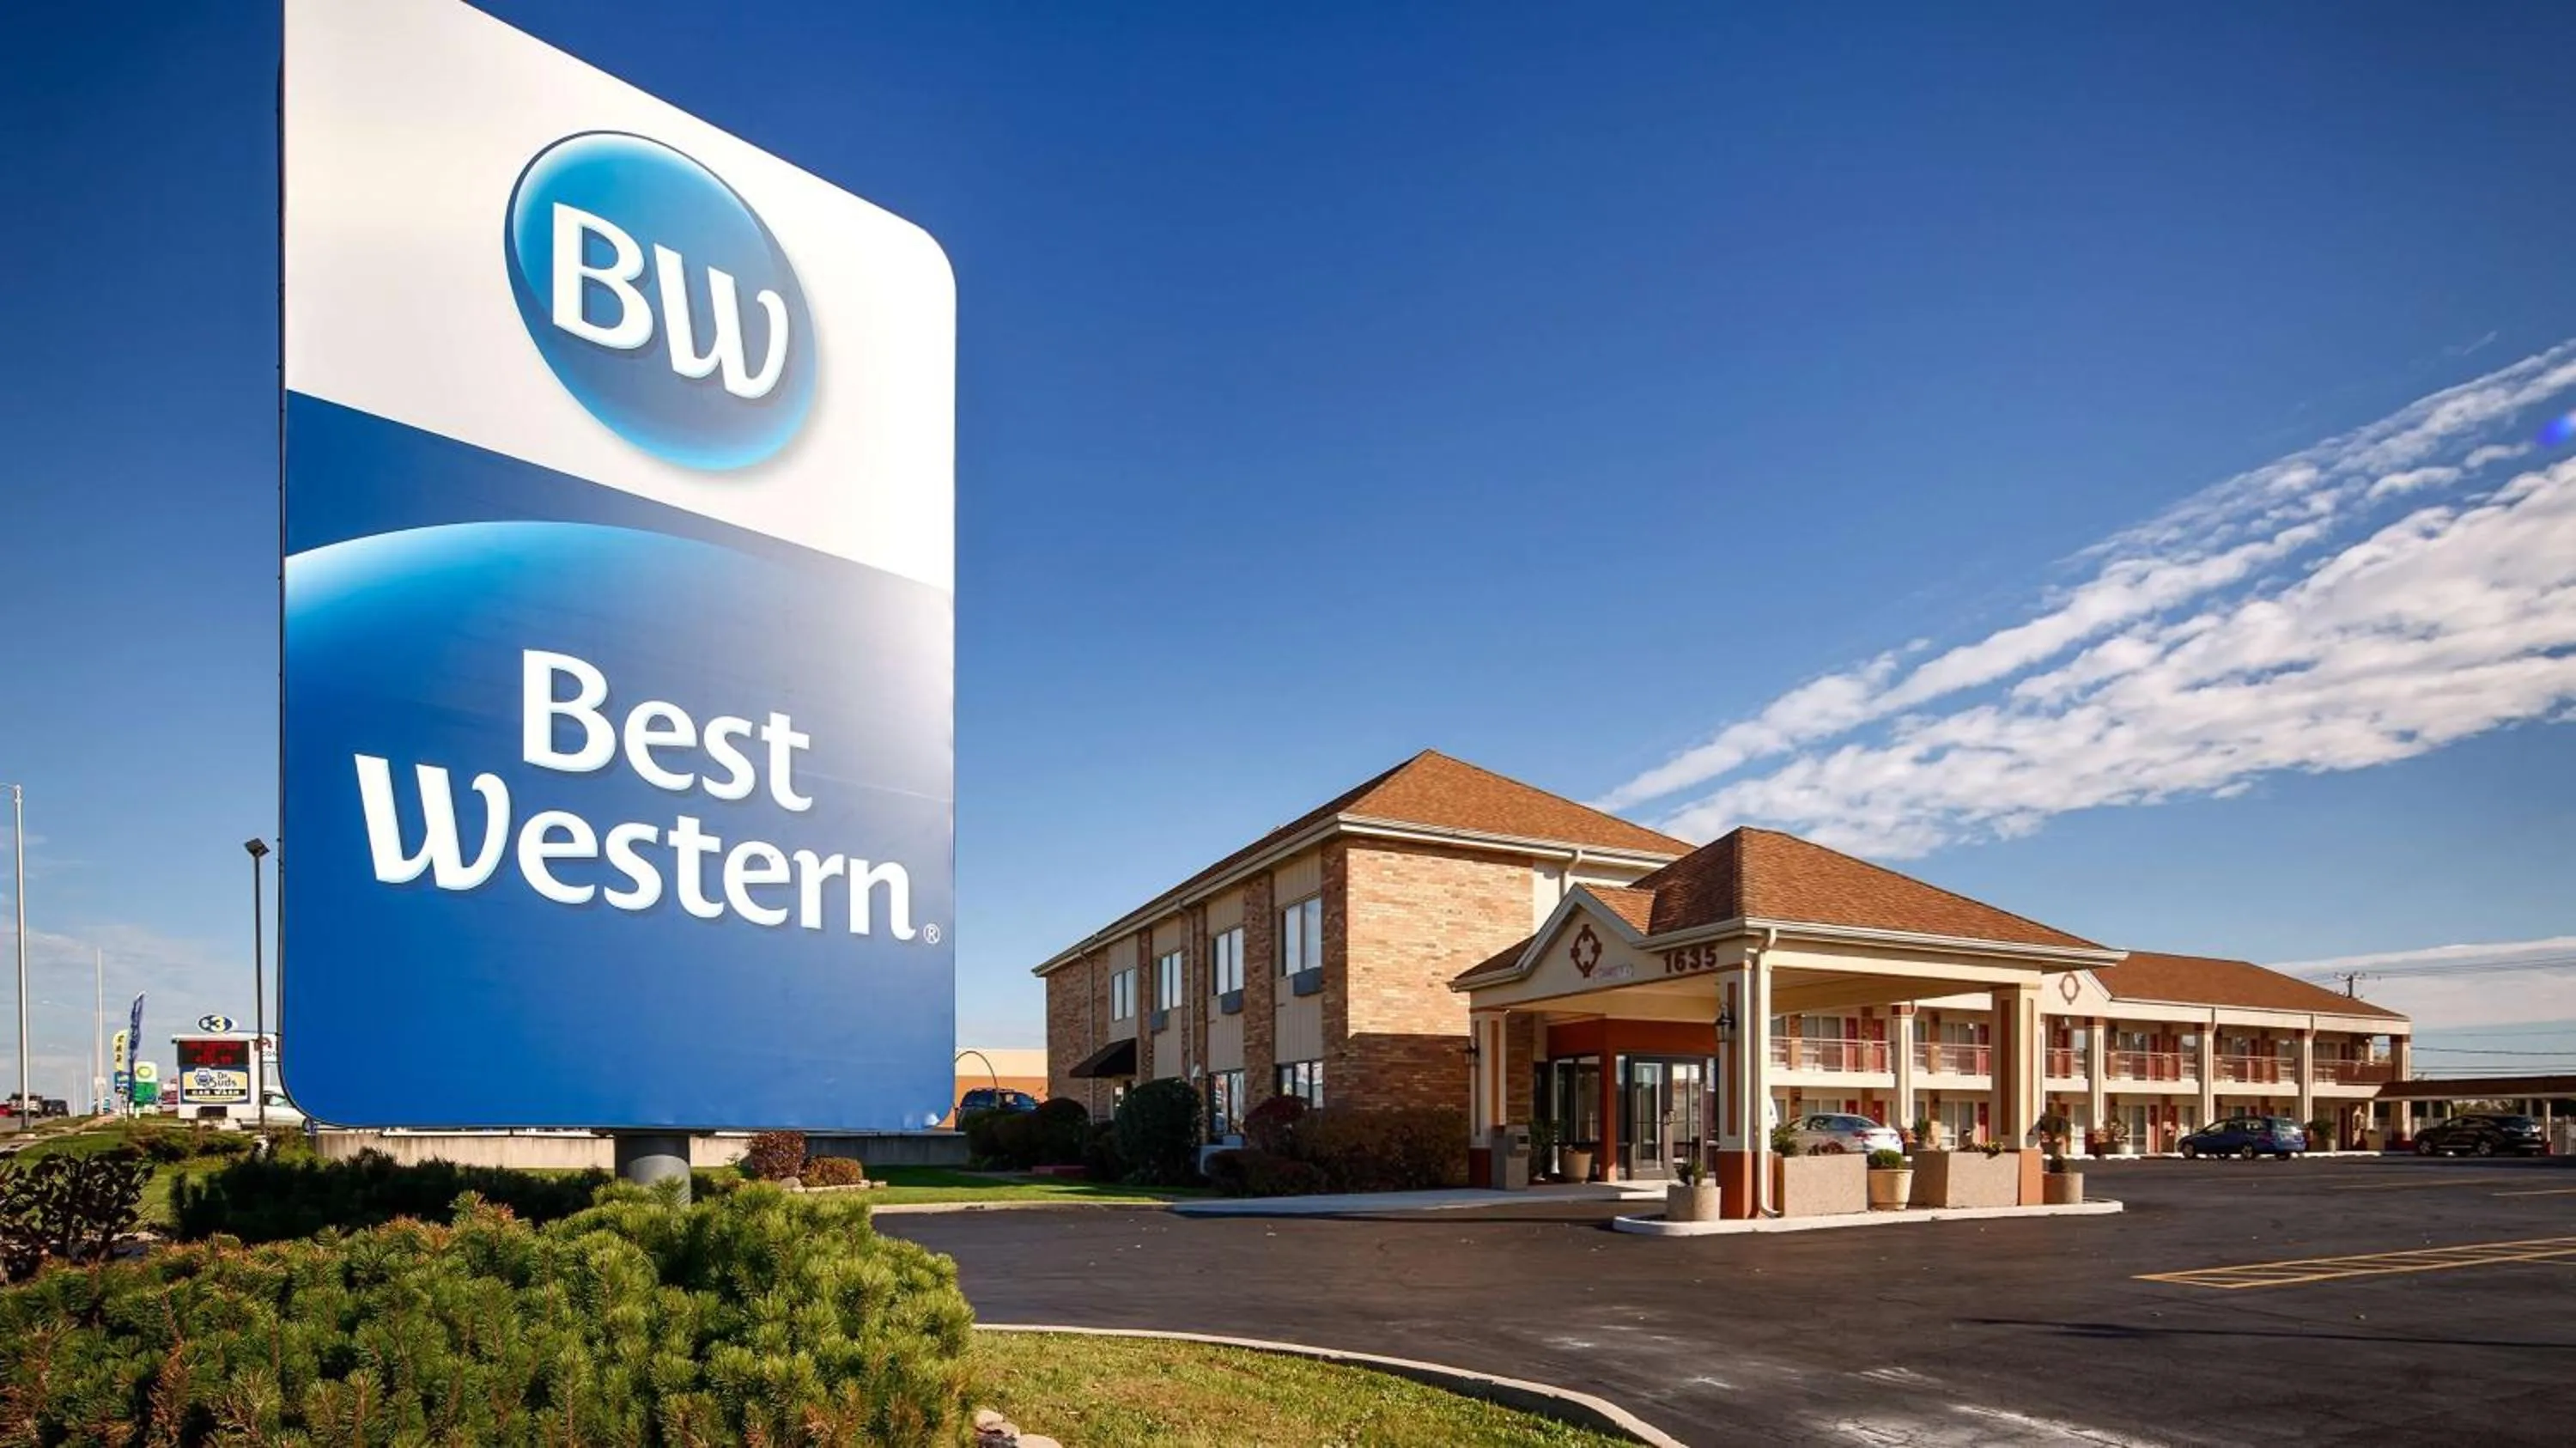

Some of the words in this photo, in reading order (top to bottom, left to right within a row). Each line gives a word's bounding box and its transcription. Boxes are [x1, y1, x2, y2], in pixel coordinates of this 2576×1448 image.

[552, 201, 789, 399] BW
[522, 648, 814, 812] Best
[354, 752, 917, 941] Western
[1663, 944, 1717, 974] 1635
[210, 1076, 237, 1087] Suds
